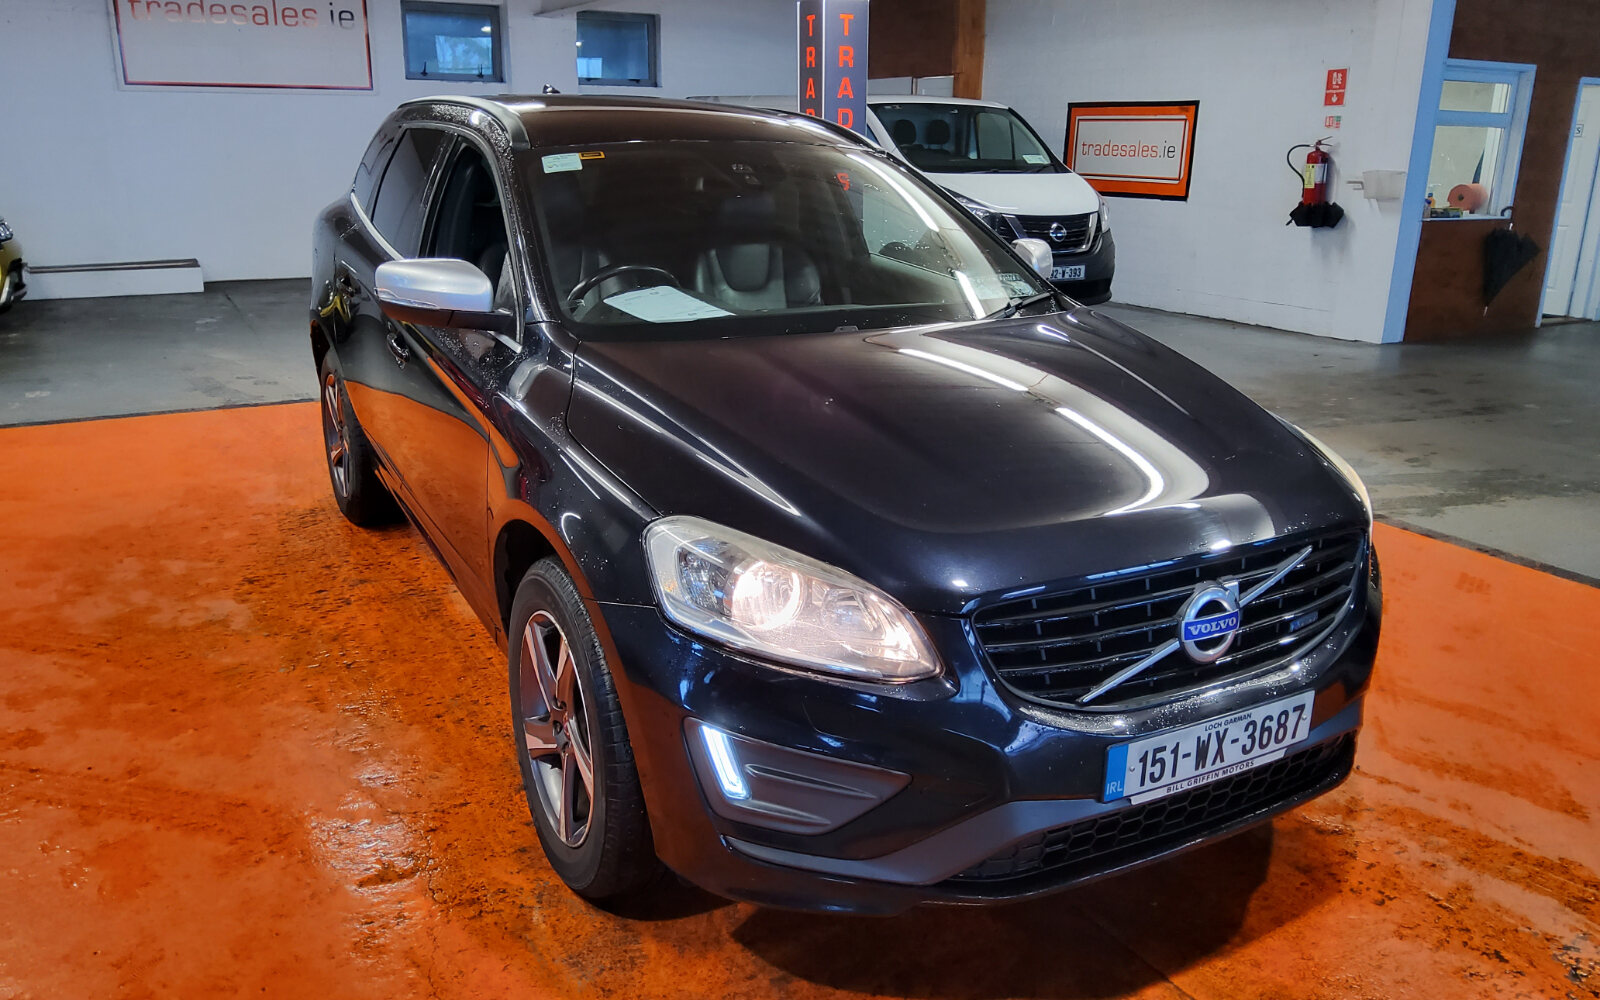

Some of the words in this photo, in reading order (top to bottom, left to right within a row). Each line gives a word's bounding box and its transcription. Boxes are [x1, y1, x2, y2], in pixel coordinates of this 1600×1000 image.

[1081, 139, 1176, 159] tradesales.ie
[1188, 617, 1236, 635] VOLVO
[1204, 721, 1223, 732] LOCH
[1223, 712, 1252, 726] GARMAN
[1138, 703, 1306, 787] 151-WX-3687
[1166, 782, 1185, 793] BILL
[1187, 771, 1220, 787] GRIFFIN
[1221, 760, 1255, 776] MOTORS
[1106, 780, 1124, 795] IRL
